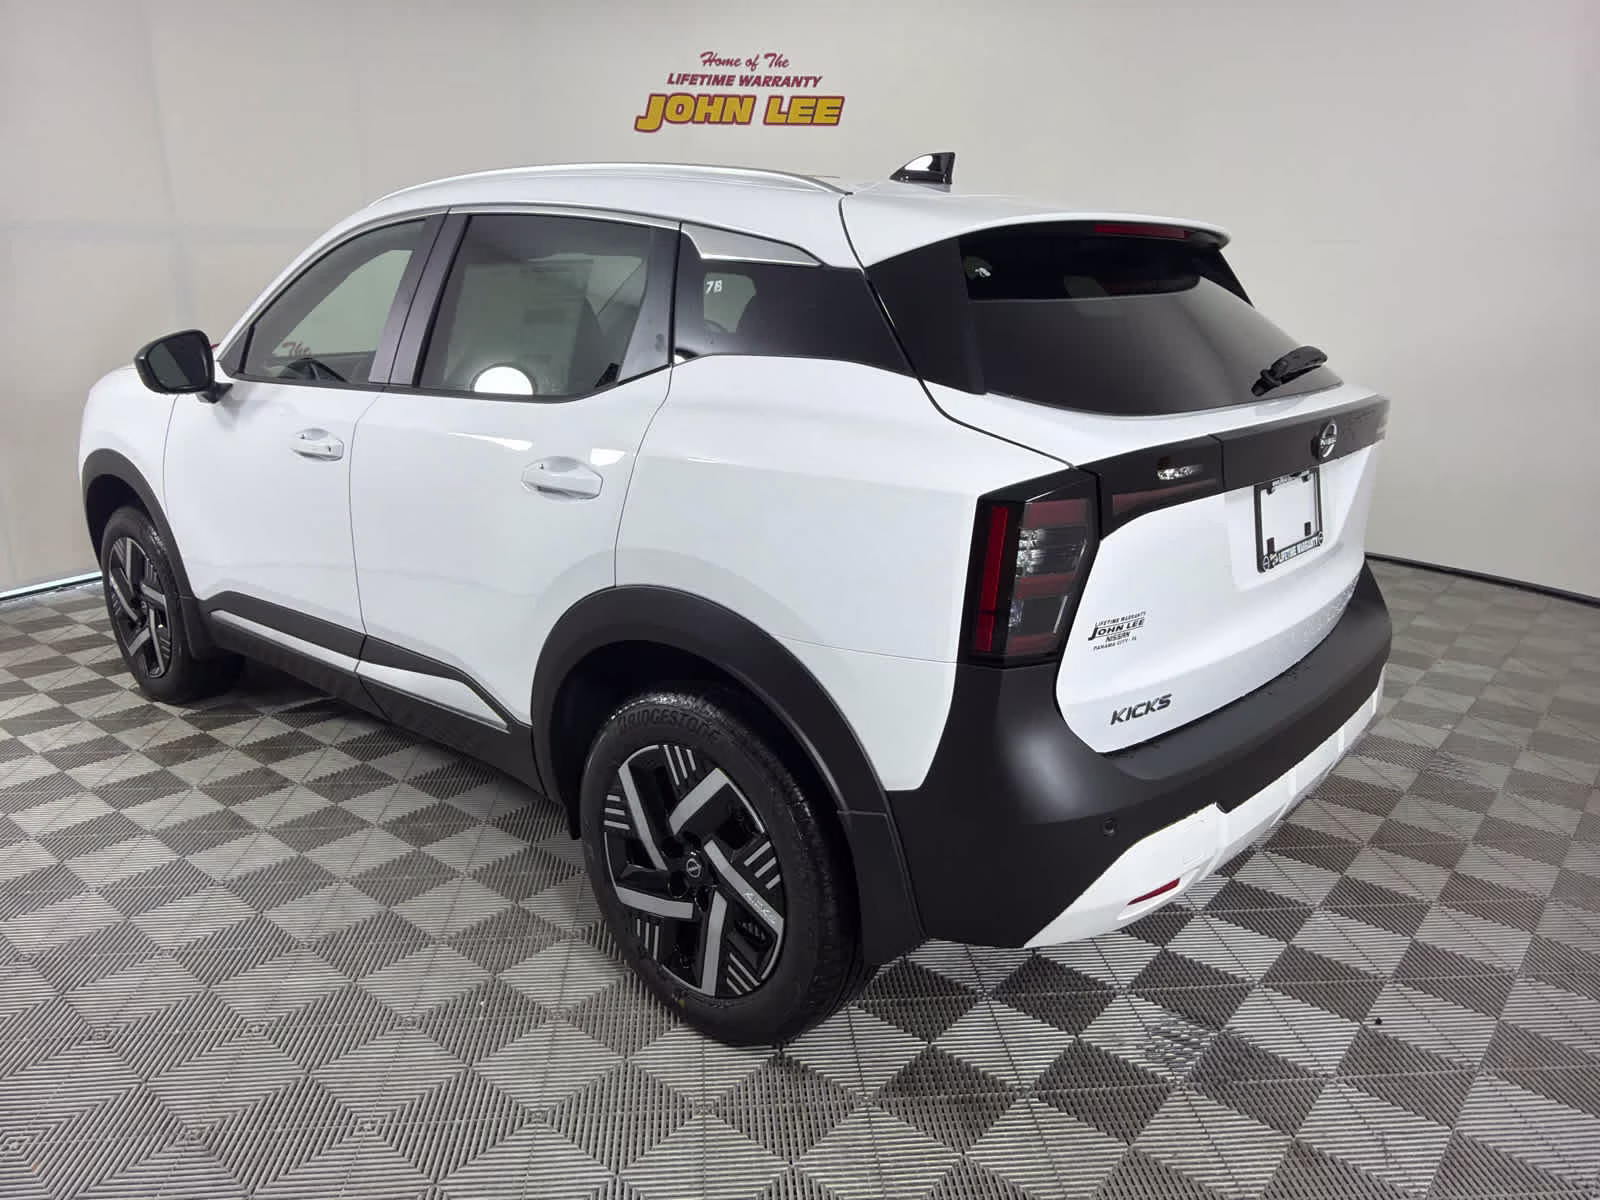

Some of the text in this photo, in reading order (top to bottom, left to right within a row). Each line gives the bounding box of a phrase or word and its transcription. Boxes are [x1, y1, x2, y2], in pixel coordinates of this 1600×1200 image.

[700, 51, 790, 71] Home of The
[666, 73, 823, 88] LIFETIME WARRANTY
[634, 92, 845, 133] JOHN LEE
[1088, 618, 1145, 641] JOHN LEE
[1110, 693, 1172, 726] KICKS
